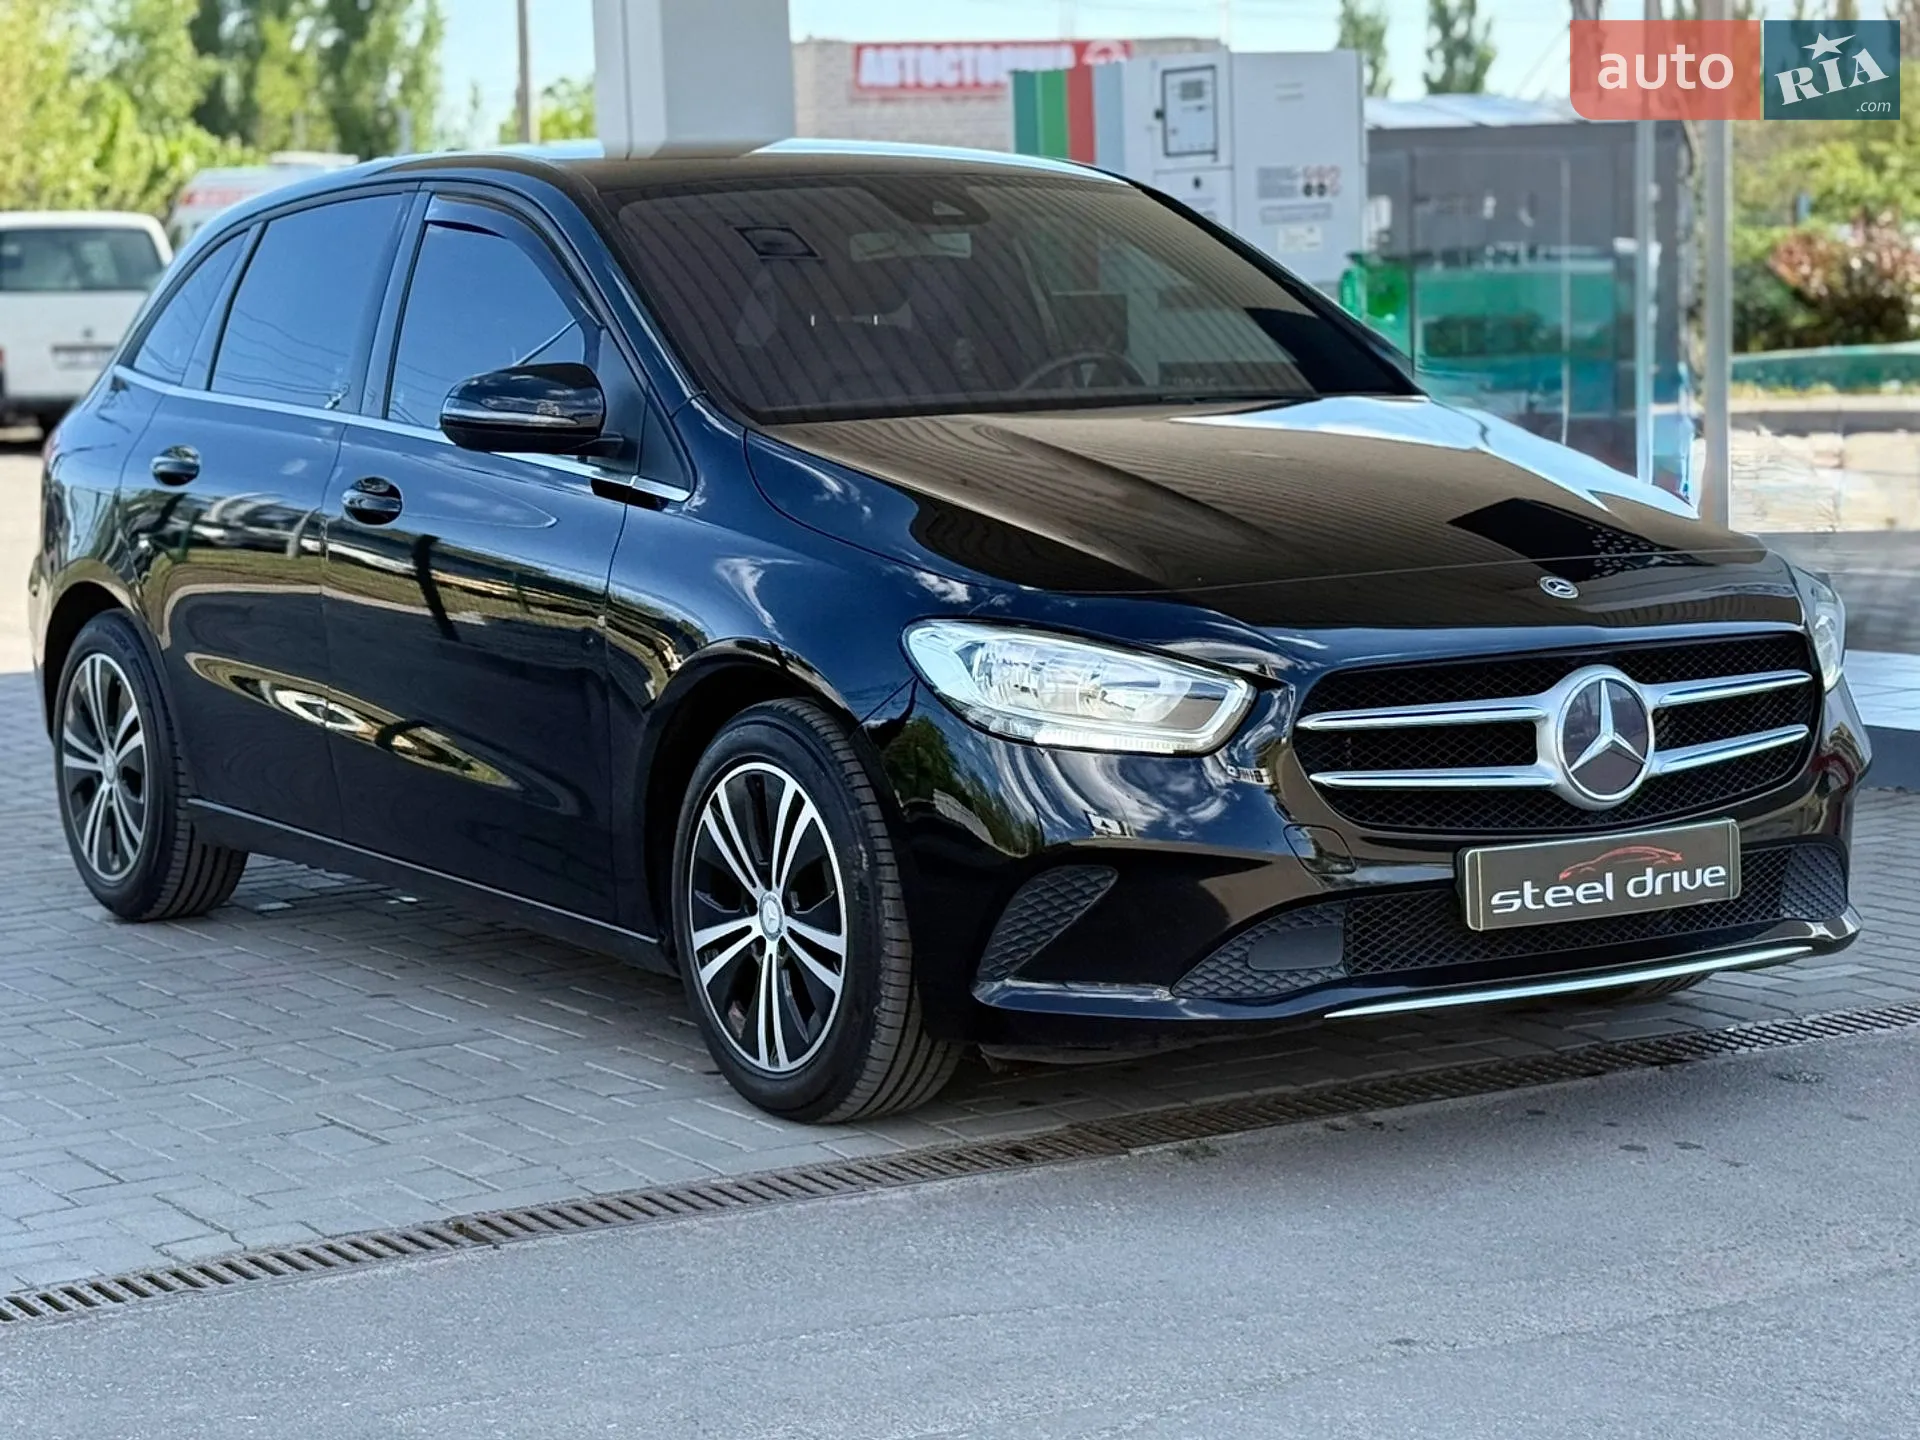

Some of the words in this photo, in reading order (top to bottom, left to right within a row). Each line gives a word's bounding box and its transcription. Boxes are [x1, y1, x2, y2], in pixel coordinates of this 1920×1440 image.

[858, 45, 1075, 87] АВТОСТО
[1490, 871, 1614, 914] steel
[1626, 864, 1726, 899] drive
